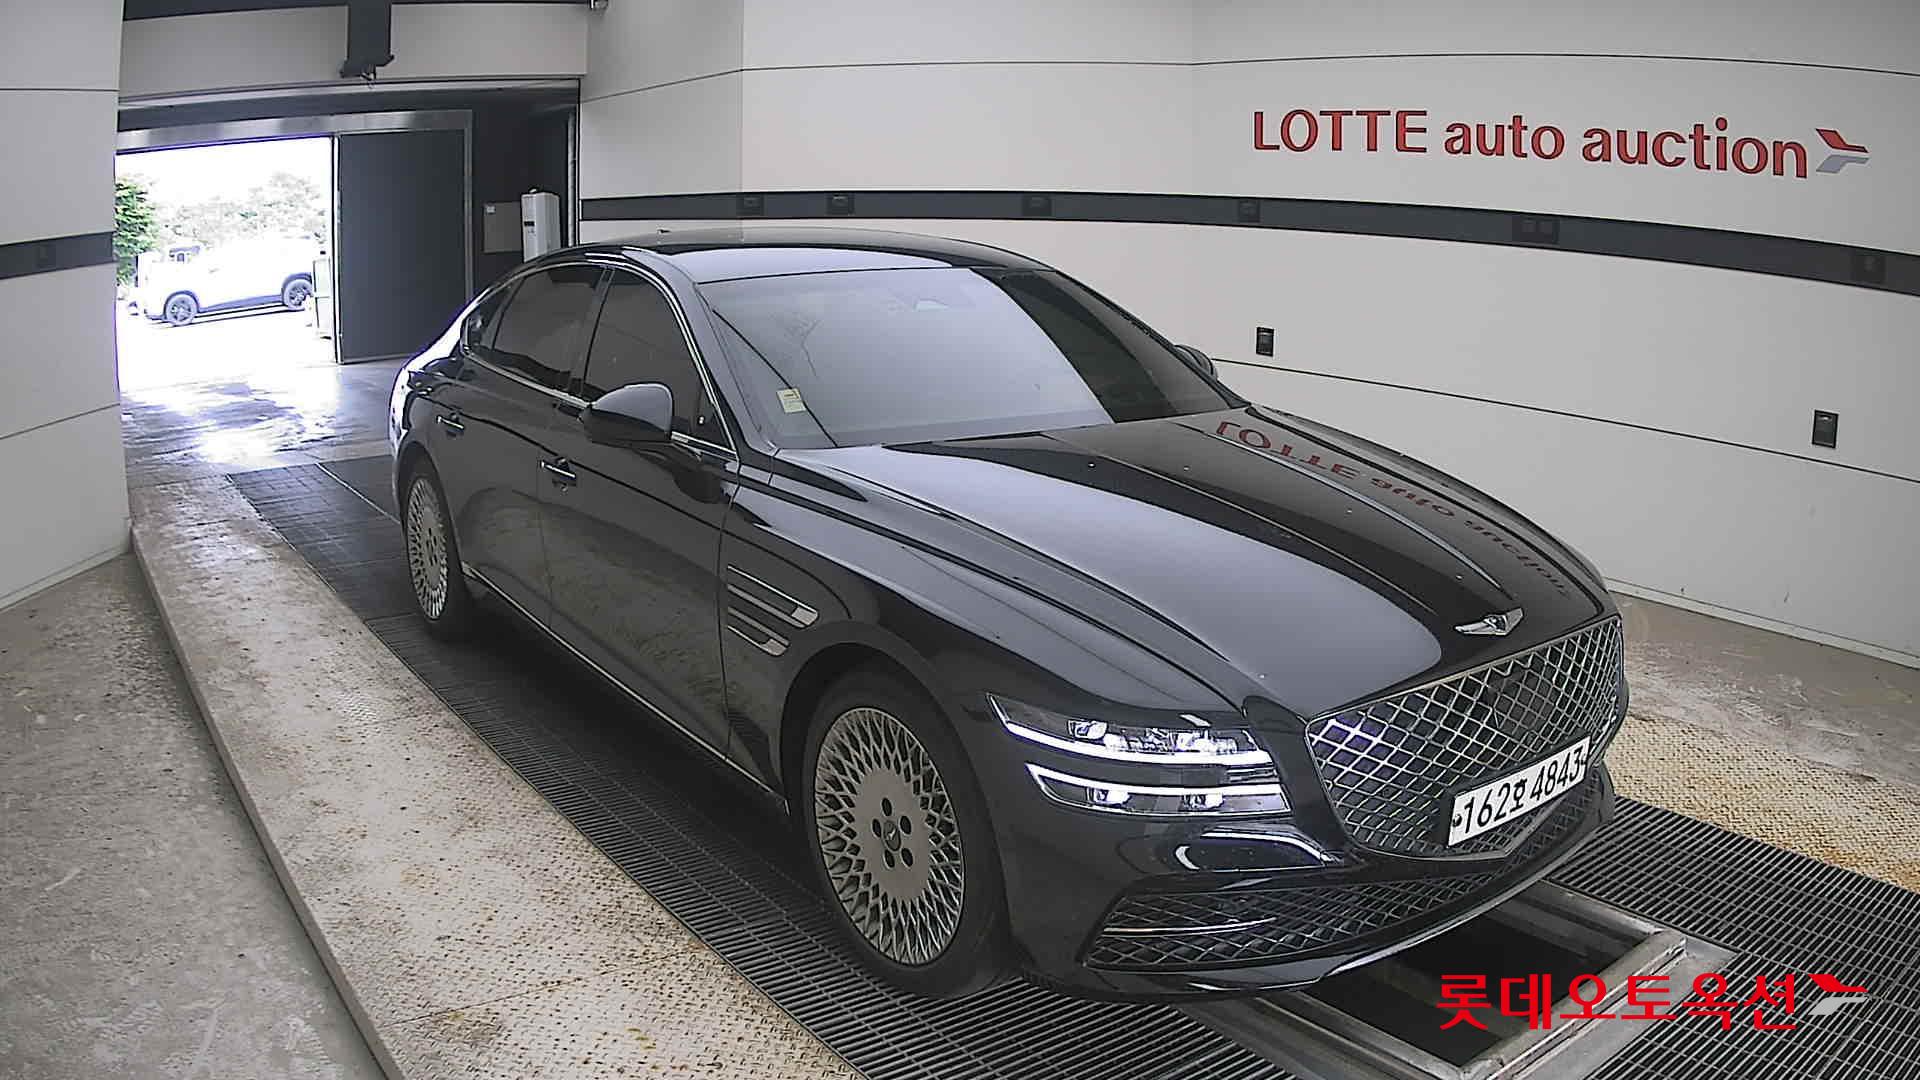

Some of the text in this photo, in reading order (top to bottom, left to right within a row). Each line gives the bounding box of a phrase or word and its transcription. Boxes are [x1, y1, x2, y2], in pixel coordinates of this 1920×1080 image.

[1253, 110, 1808, 179] LOTTE auto auction
[1464, 746, 1583, 833] 162호 4843
